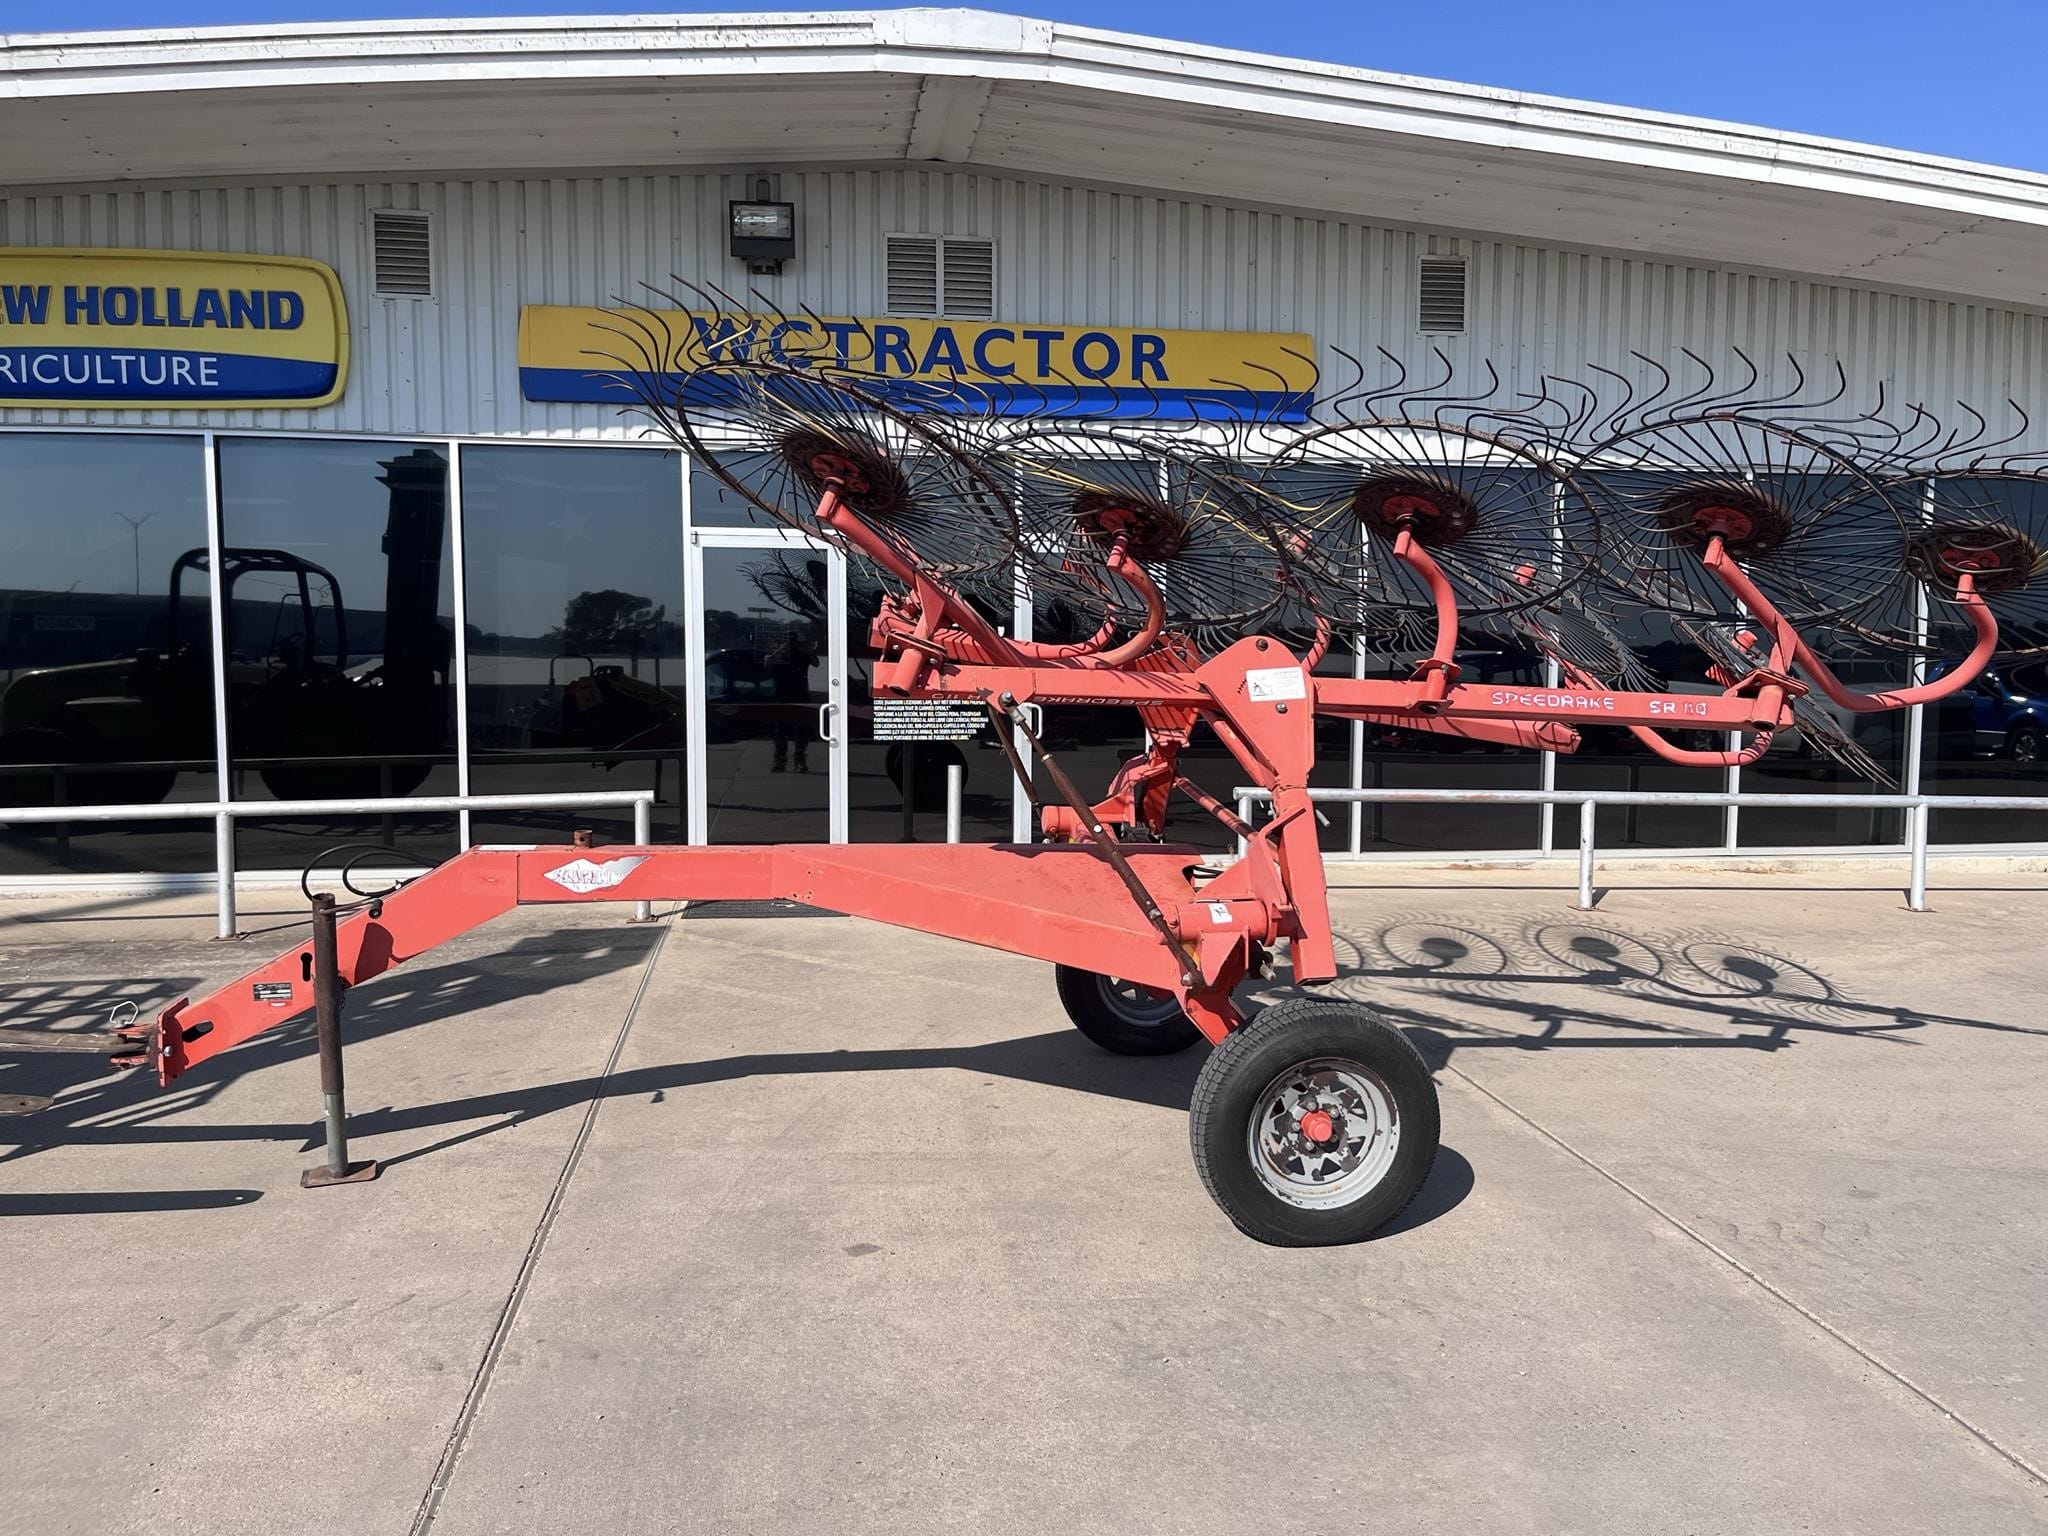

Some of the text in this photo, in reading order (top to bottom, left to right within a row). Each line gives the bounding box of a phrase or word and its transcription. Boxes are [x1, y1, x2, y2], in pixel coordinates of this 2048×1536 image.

[0, 285, 304, 330] W HOLLAND
[1032, 696, 1164, 706] SPEEDRAKE
[1491, 692, 1615, 710] SPEEDRAKE
[1649, 700, 1676, 714] SR
